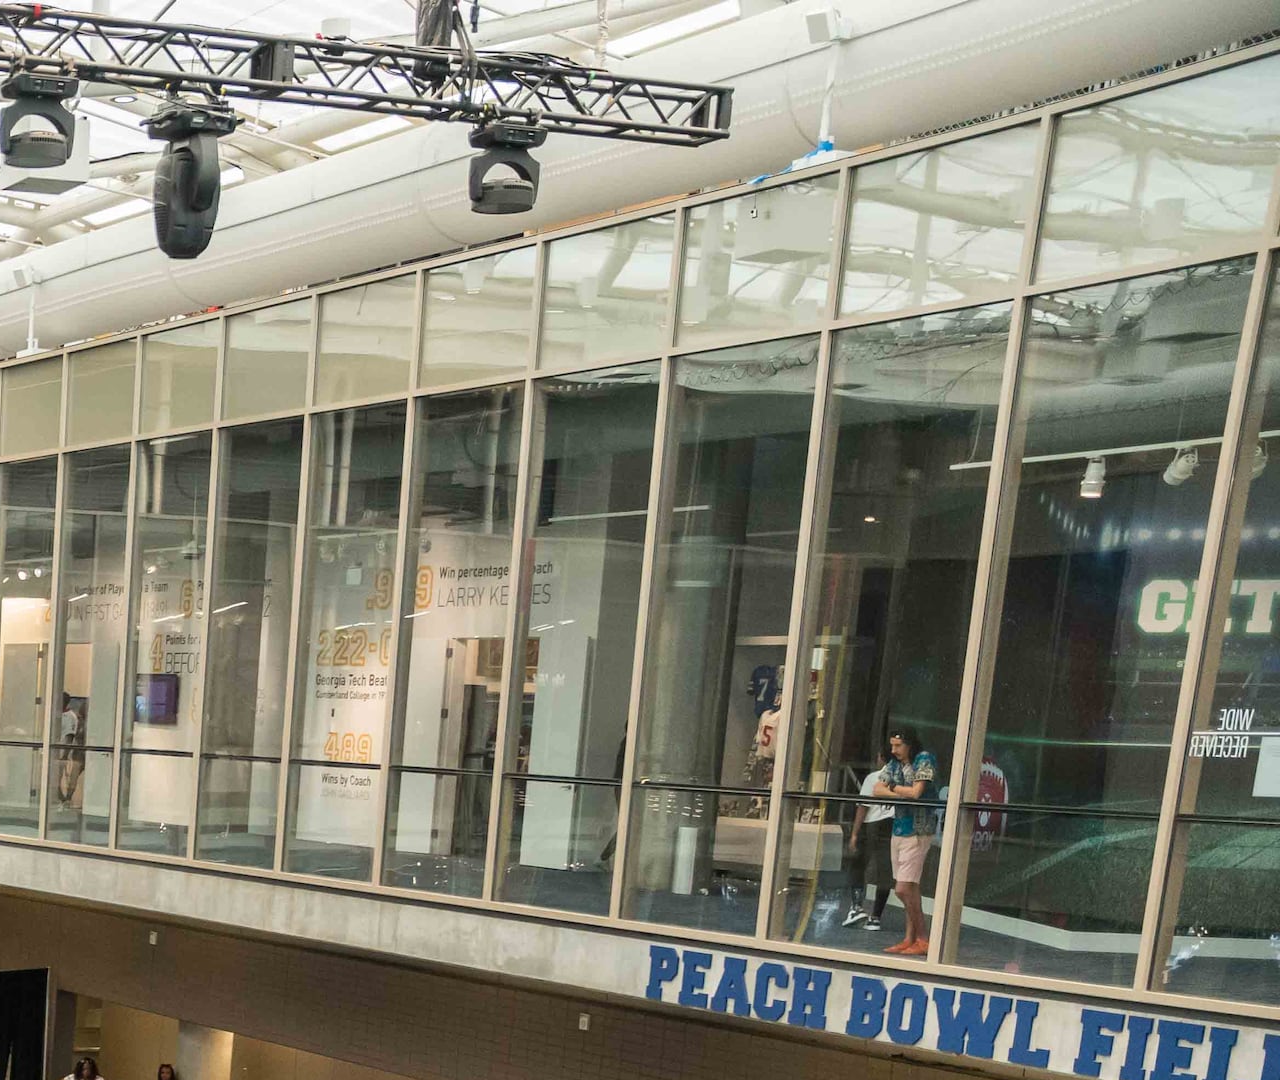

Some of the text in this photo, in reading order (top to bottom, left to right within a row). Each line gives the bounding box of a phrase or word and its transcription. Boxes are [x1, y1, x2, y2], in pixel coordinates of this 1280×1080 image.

[440, 567, 456, 578] Win
[458, 564, 509, 579] percentage
[366, 566, 434, 610] .99
[438, 584, 552, 608] LARRY KEES
[1137, 579, 1280, 634] GT
[166, 633, 197, 645] Points for
[150, 633, 164, 672] 4
[316, 674, 346, 688] Georgia
[348, 673, 367, 686] Tech
[757, 678, 771, 702] 7
[324, 732, 372, 763] 489
[321, 773, 371, 787] Wins by Coach
[646, 945, 832, 1031] PEACH
[845, 976, 1049, 1069] BOWL
